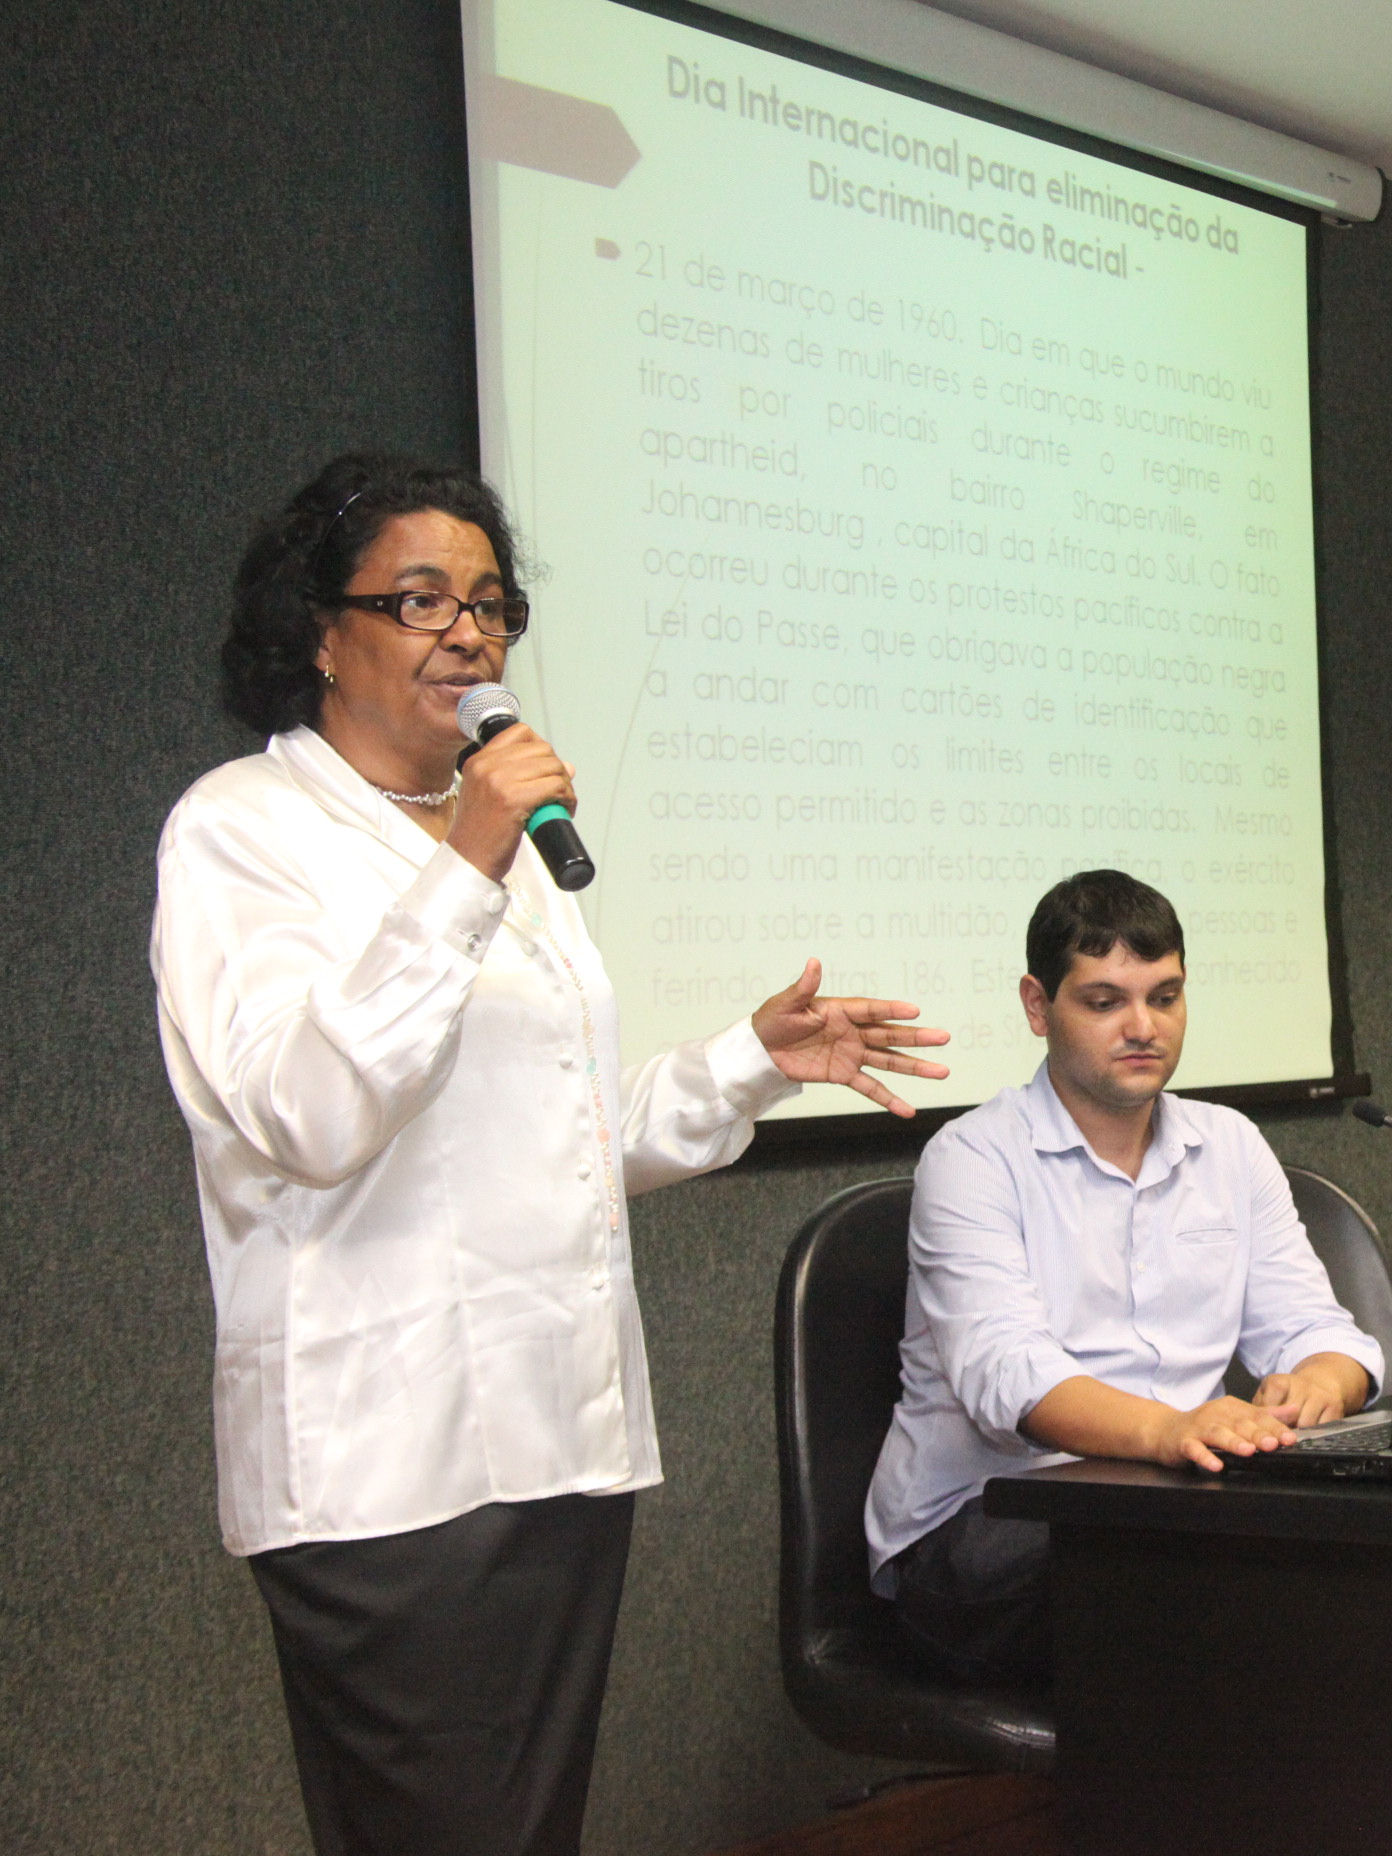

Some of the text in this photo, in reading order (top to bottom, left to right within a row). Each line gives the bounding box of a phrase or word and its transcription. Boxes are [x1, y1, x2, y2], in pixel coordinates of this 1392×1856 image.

[667, 54, 1239, 255] Dia Internacional para eliminação da
[809, 159, 1036, 254] Discriminação
[1042, 223, 1128, 279] Racial
[634, 240, 1272, 411] 21 de março de 1960. Dia em que o mundo viu
[636, 300, 1275, 458] dezenas de mulheres e crianças sucumbirem a
[637, 357, 1276, 505] tiros por policiais durante o regime do
[639, 427, 807, 484] apartheid,
[861, 462, 898, 492] no
[950, 468, 1026, 512] bairro
[1244, 524, 1278, 550] em
[640, 478, 865, 550] Johannesburg
[894, 519, 989, 560] capital
[1000, 529, 1035, 564] da
[1046, 527, 1116, 575] África
[1125, 547, 1156, 581] do
[1209, 558, 1229, 591] O
[1237, 561, 1281, 598] fato
[642, 547, 769, 587] ocorreu
[782, 554, 898, 601] durante
[908, 577, 938, 605] os
[947, 579, 1065, 620] protestos
[1188, 609, 1262, 643] contra
[1268, 621, 1284, 645] a
[644, 598, 688, 638] Lei
[701, 604, 744, 643] do
[861, 627, 916, 664] que
[928, 627, 1047, 673] obrigava
[1056, 646, 1073, 673] a
[1082, 649, 1213, 688] população
[1221, 663, 1286, 699] negra
[645, 666, 1287, 747] a andar com cartões de identificação que
[646, 722, 1290, 789] estabeleciam os limites entre os locais de
[648, 790, 762, 822] acesso
[775, 788, 917, 830] permitido
[930, 799, 946, 825] e
[959, 799, 987, 827] as
[999, 799, 1070, 830] zonas
[1215, 805, 1293, 836] Mesmo
[649, 846, 749, 882] sendo
[769, 852, 838, 882] uma
[856, 846, 1045, 887] manifestação
[1182, 860, 1196, 884] o
[1209, 854, 1296, 885] exército
[650, 905, 747, 945] atirou
[759, 903, 843, 942] sobre
[855, 911, 875, 940] a
[1188, 910, 1276, 942] pessoas
[1285, 911, 1298, 934] e
[651, 967, 767, 1007] ferindo
[1184, 953, 1300, 986] onhecido
